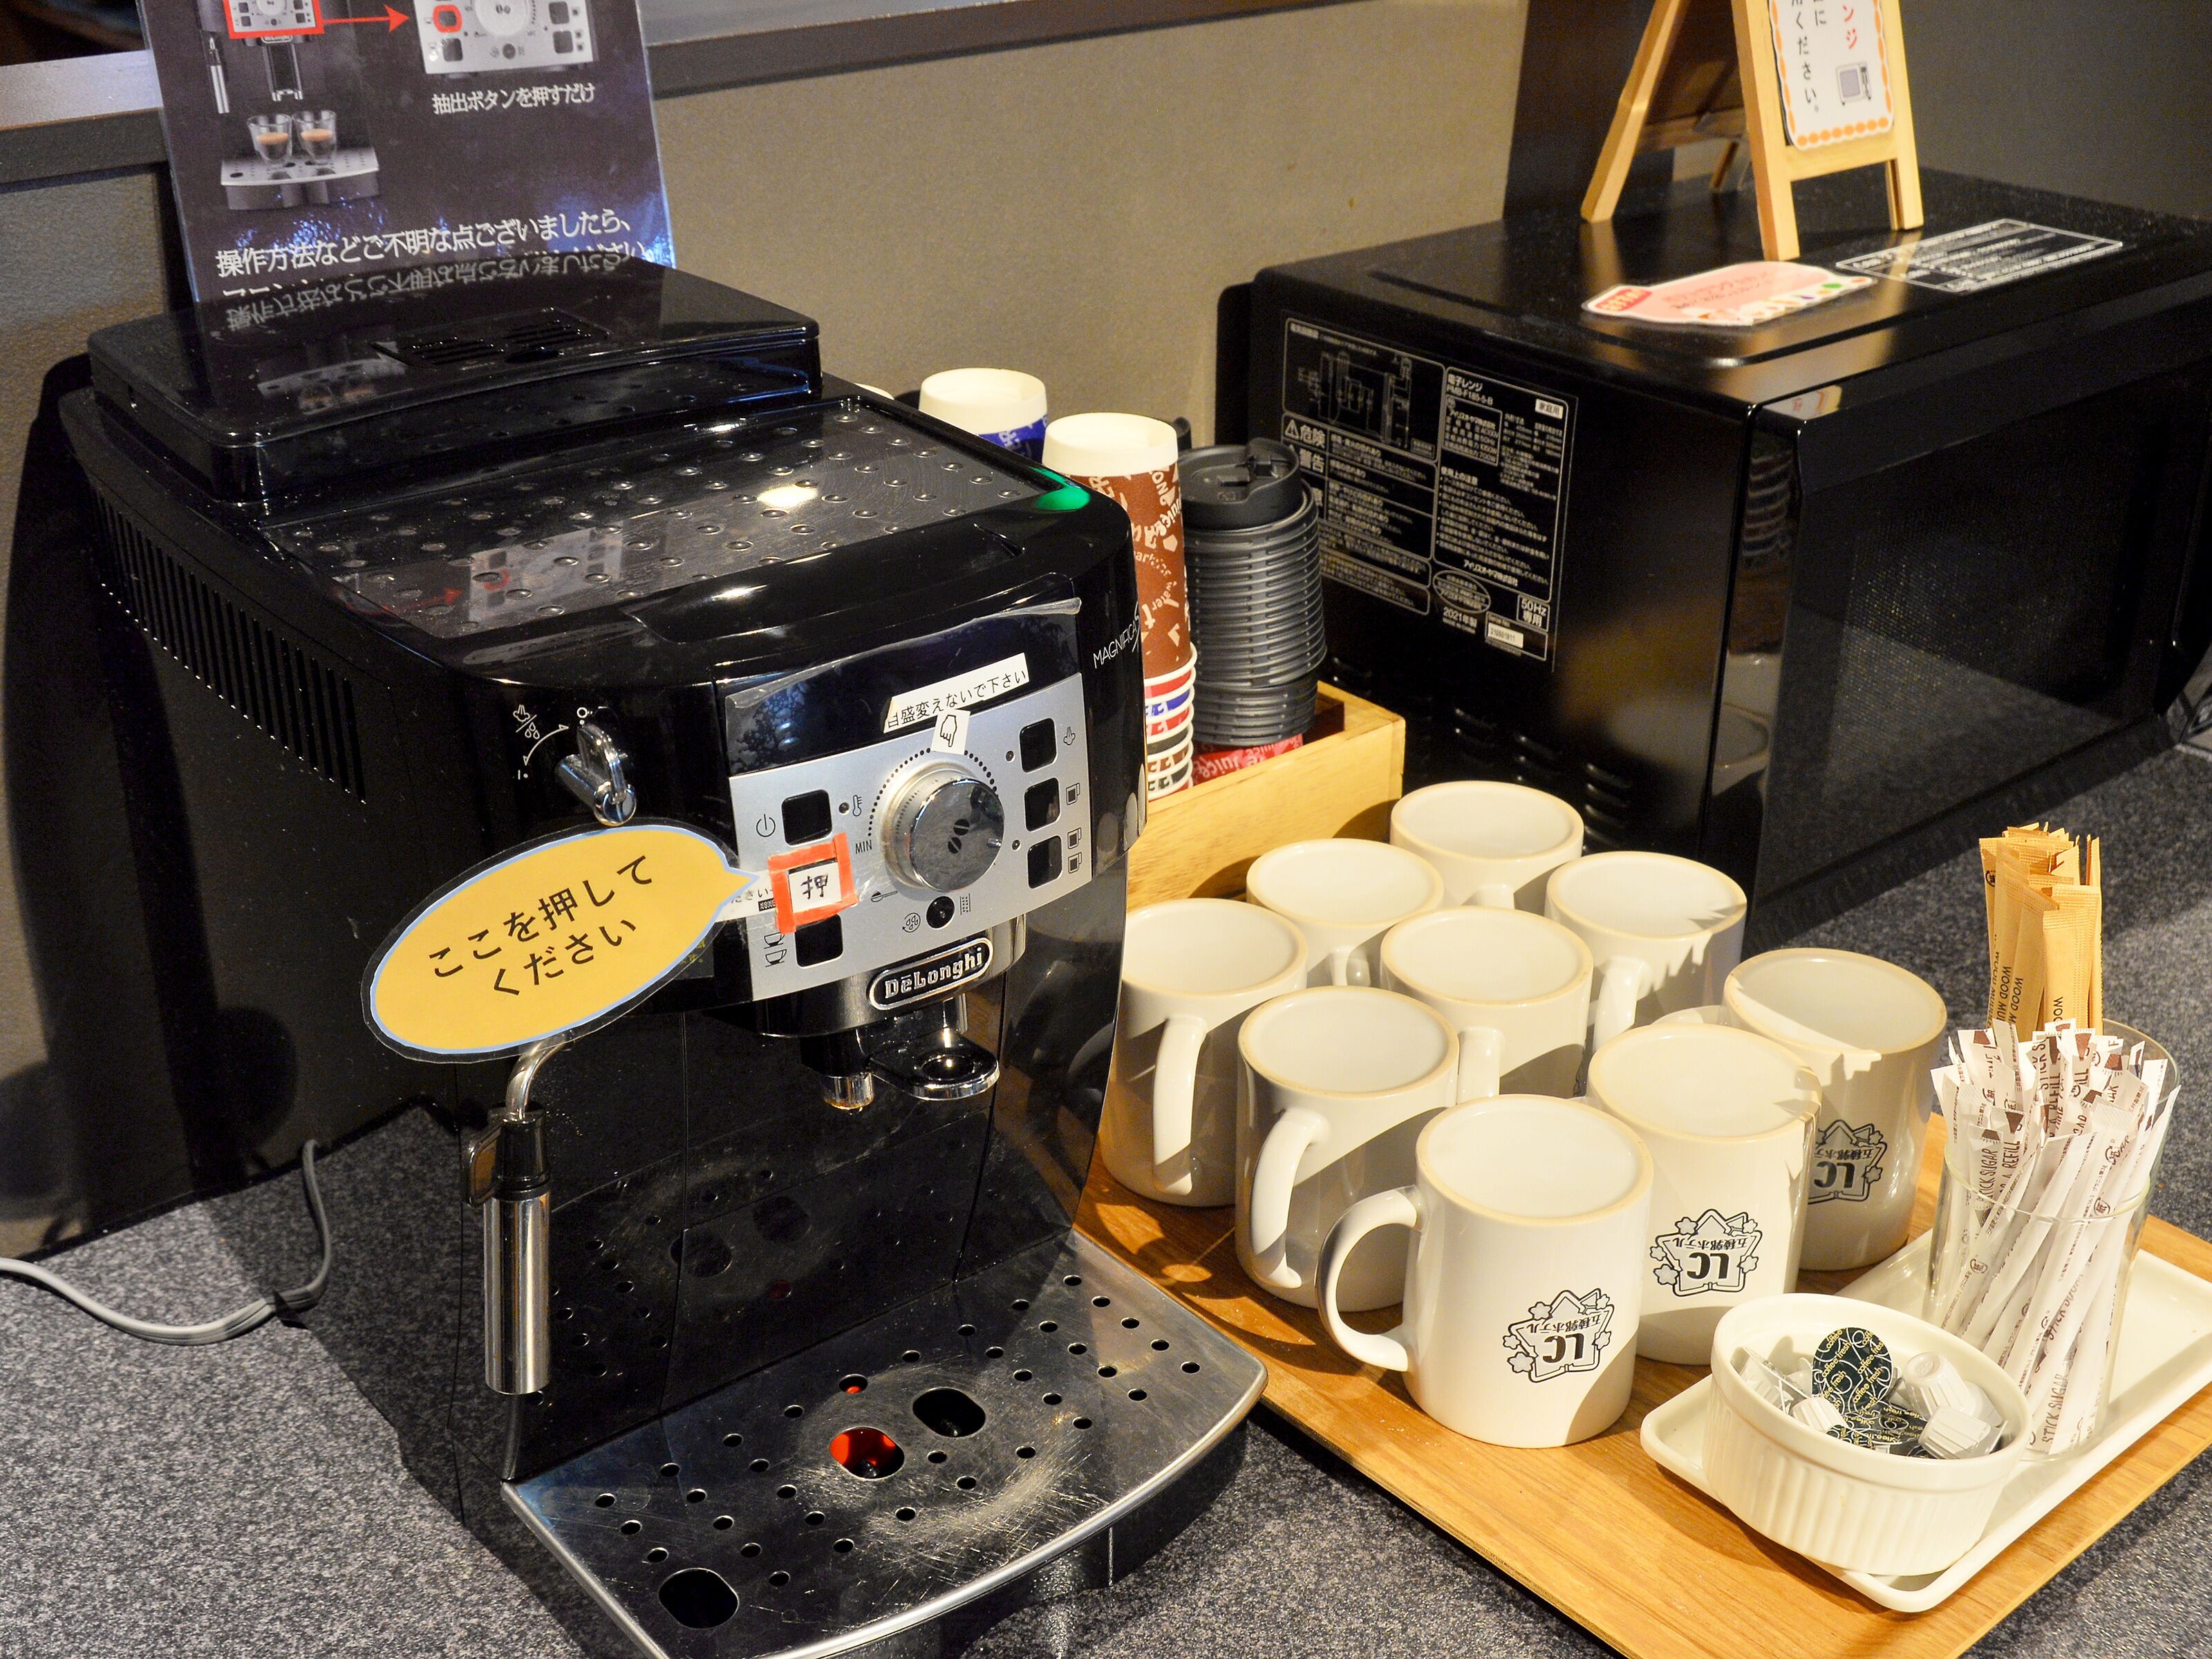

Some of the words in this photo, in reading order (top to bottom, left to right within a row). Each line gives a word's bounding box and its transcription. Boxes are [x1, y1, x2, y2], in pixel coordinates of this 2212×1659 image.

[431, 82, 596, 115] 抽出ボタンを押すだけ
[215, 208, 630, 277] 操作方法などご不明な点ございましたら、
[1300, 424, 1326, 449] 危険
[1521, 598, 1548, 617] 50Hz
[855, 839, 872, 854] MIN
[800, 874, 829, 899] 押
[428, 854, 654, 978] ここを押して
[492, 919, 637, 997] ください
[2000, 966, 2012, 1000] WOOD
[2010, 977, 2024, 1011] WOOD
[1814, 1161, 1855, 1188] LC
[1980, 1148, 1998, 1177] SUGAR
[1687, 1252, 1730, 1280] LC
[1542, 1333, 1584, 1363] LC
[1821, 1358, 1839, 1378] coffee
[1835, 1341, 1852, 1359] fresh
[1830, 1370, 1846, 1387] fresh
[1857, 1354, 1875, 1374] coffee
[1852, 1383, 1871, 1403] coffee
[1866, 1367, 1883, 1384] fresh
